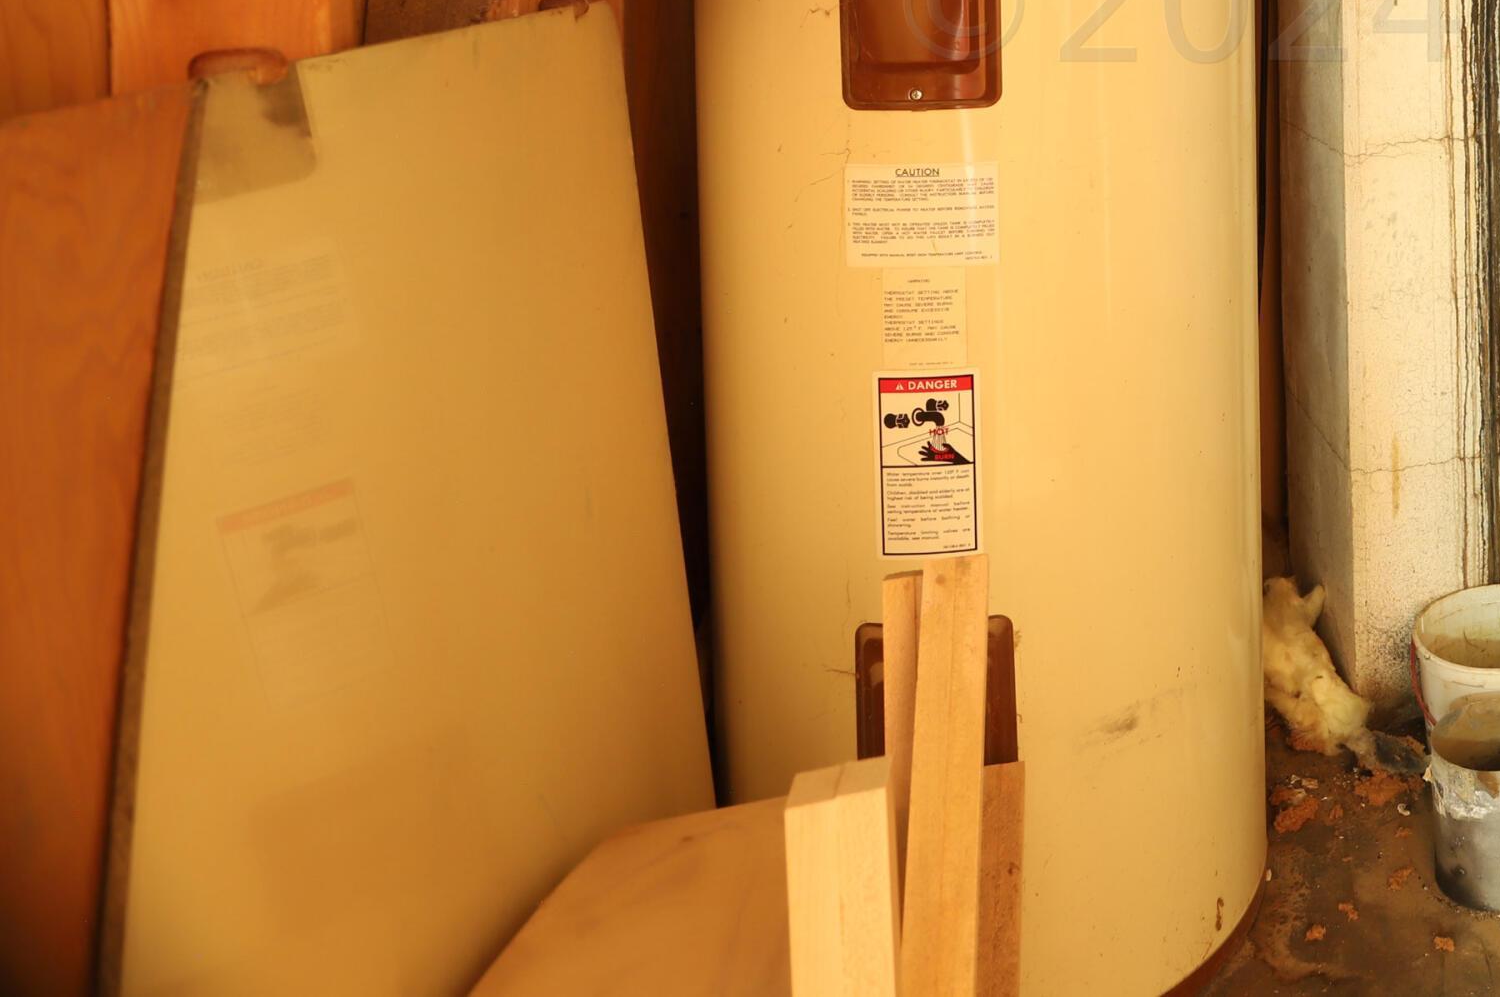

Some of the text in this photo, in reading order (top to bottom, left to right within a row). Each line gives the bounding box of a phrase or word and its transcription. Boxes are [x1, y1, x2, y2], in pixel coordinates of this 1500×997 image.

[895, 168, 940, 177] CAUTION
[908, 379, 958, 391] DANGER
[928, 426, 949, 436] HOT
